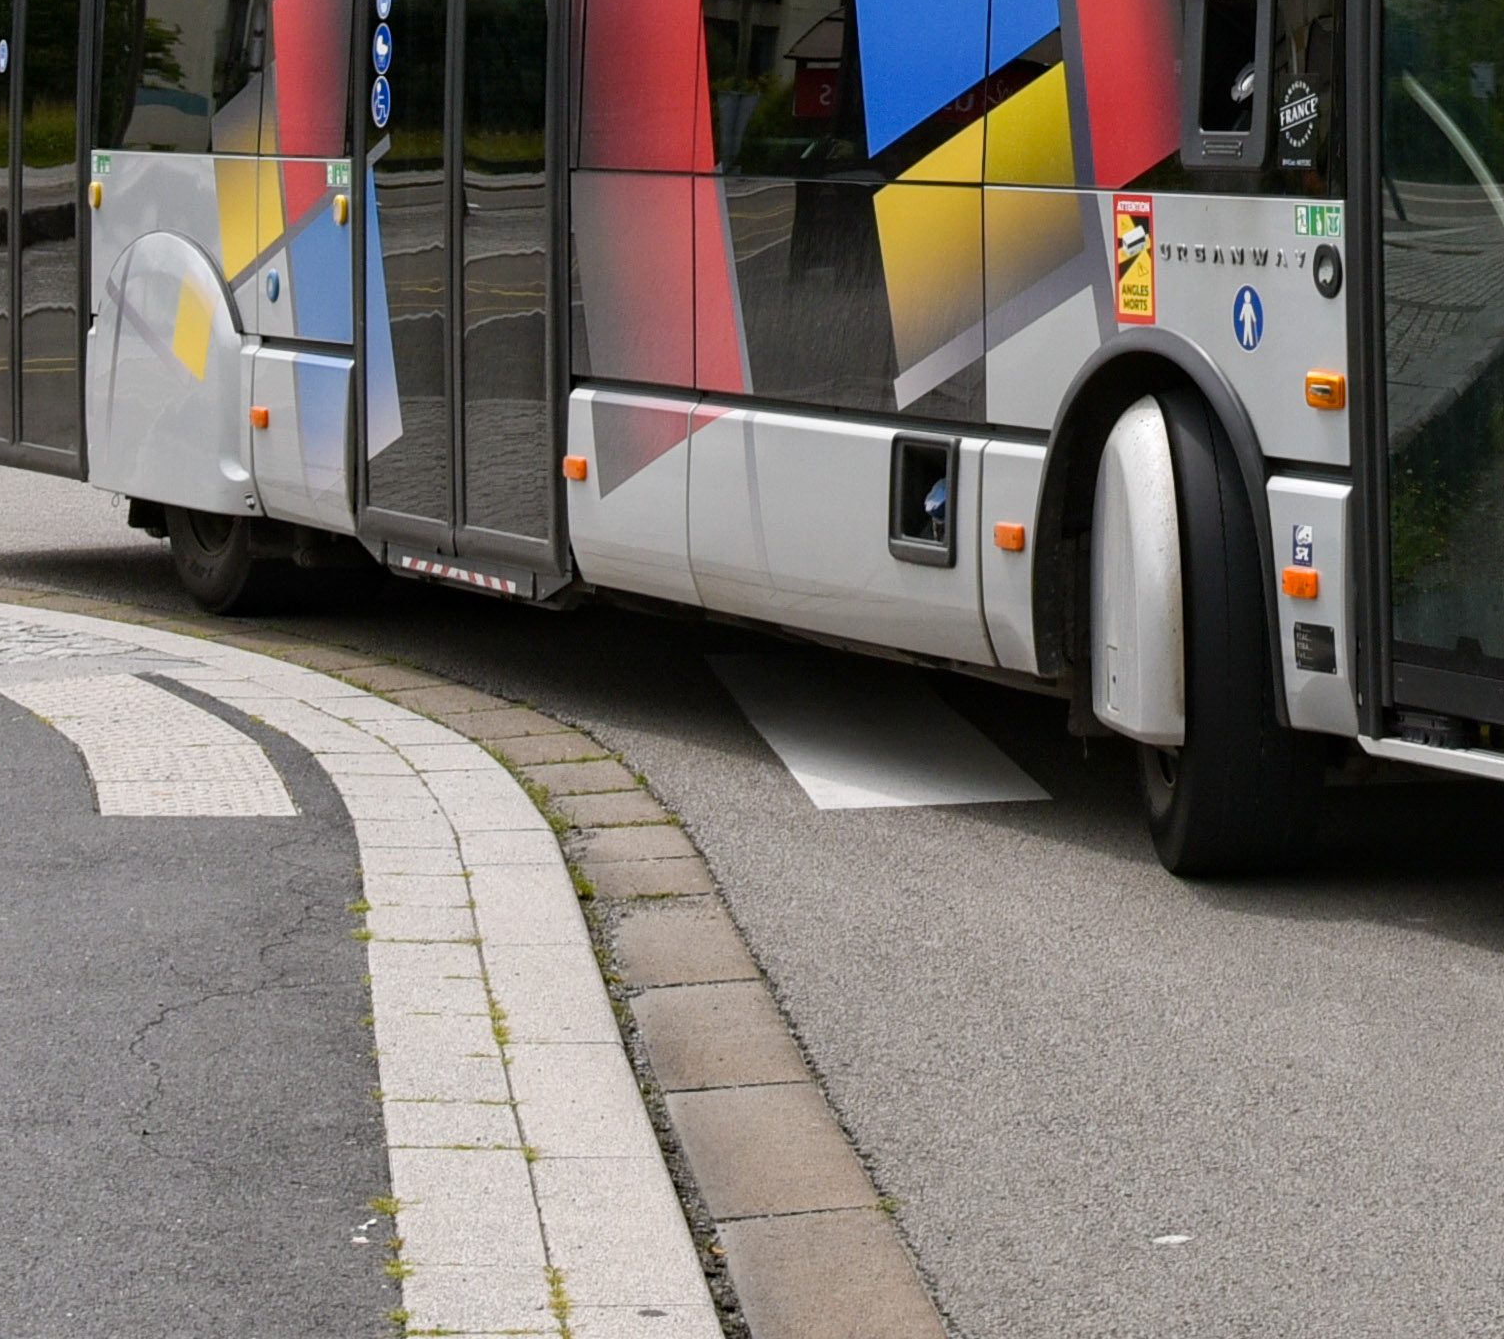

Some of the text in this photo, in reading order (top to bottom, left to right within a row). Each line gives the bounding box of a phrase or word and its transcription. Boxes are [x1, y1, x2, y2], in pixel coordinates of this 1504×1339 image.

[1280, 97, 1317, 127] FRANCE
[1160, 243, 1306, 269] URBANWAY
[1122, 284, 1149, 297] ANGLES
[1123, 298, 1148, 311] MORTS
